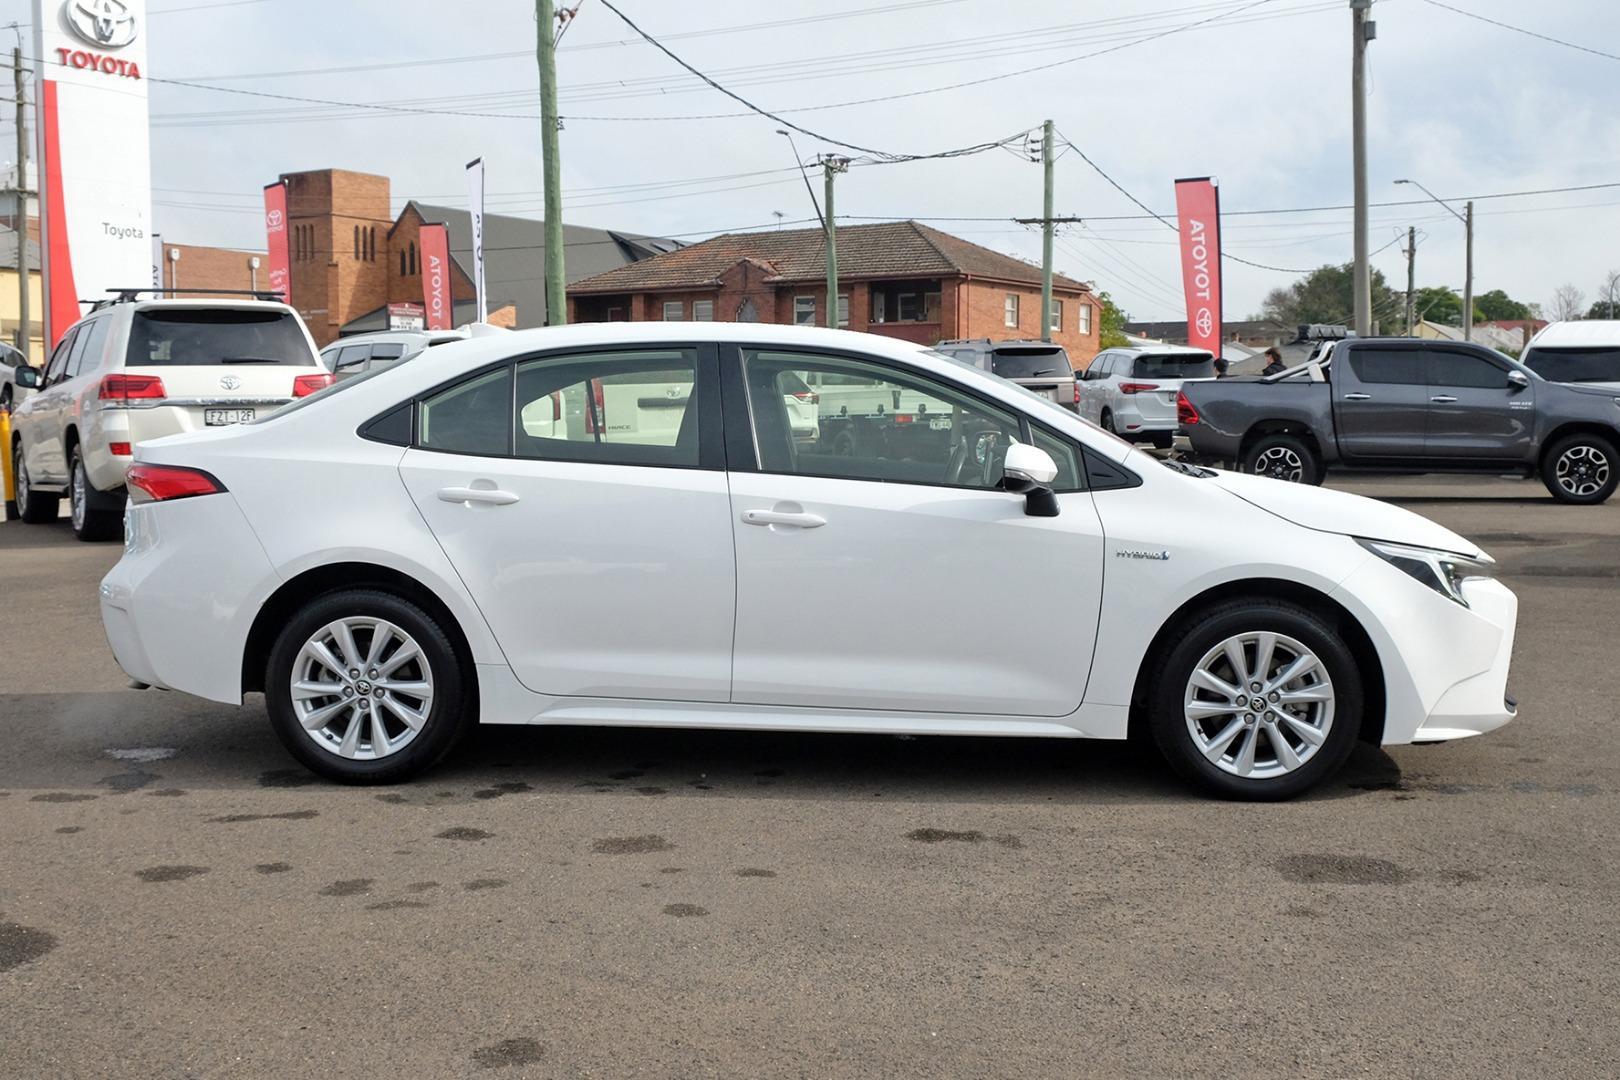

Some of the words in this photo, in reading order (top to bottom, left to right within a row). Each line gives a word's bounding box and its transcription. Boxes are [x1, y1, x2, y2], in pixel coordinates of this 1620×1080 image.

[57, 47, 141, 80] TOYOTA
[102, 222, 143, 240] Toyota
[1116, 549, 1161, 561] HYBRID
